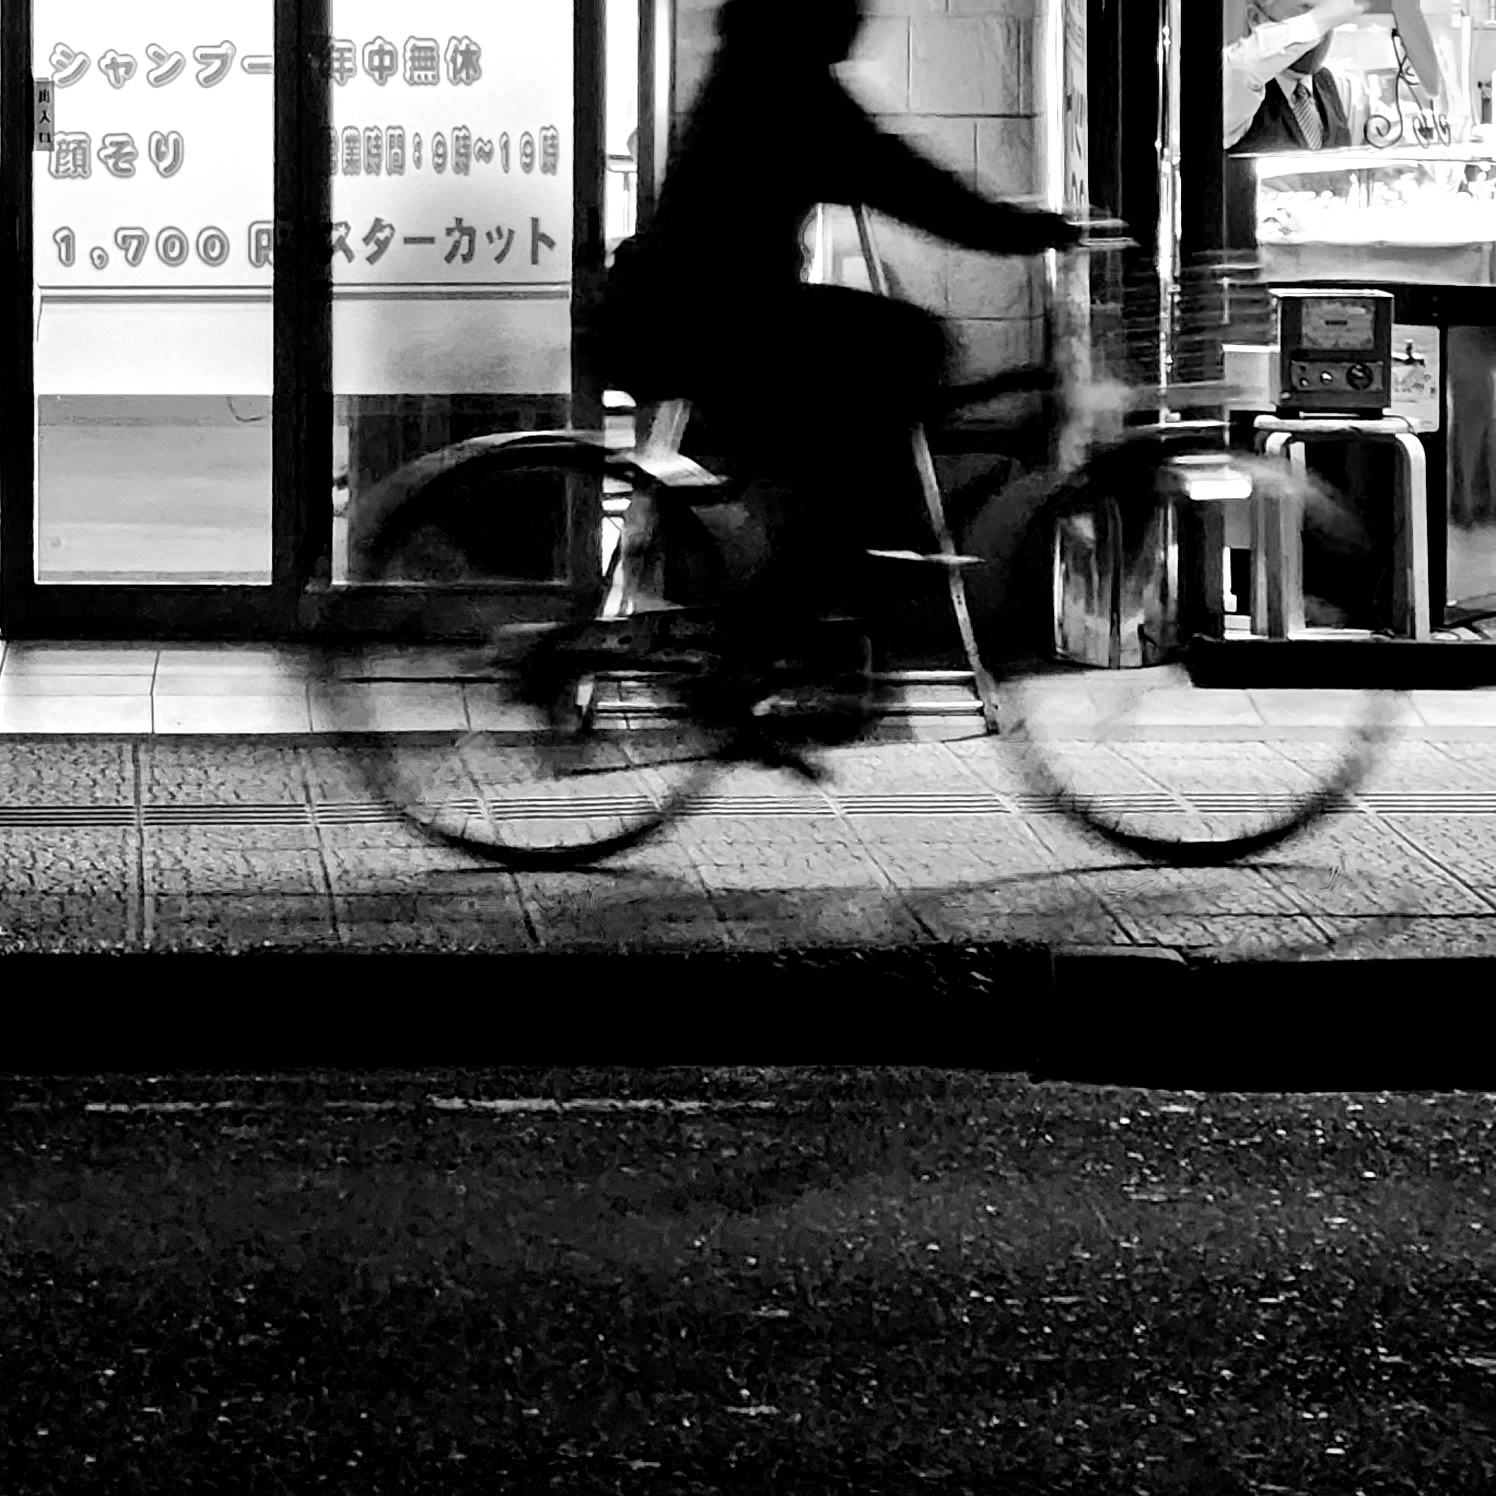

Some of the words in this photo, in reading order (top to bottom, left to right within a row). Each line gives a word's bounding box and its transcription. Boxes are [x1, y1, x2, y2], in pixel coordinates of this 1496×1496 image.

[49, 41, 272, 88] シャンプー
[332, 36, 482, 86] 年中無休
[50, 131, 184, 179] 顔そり
[332, 216, 556, 266] スターカット
